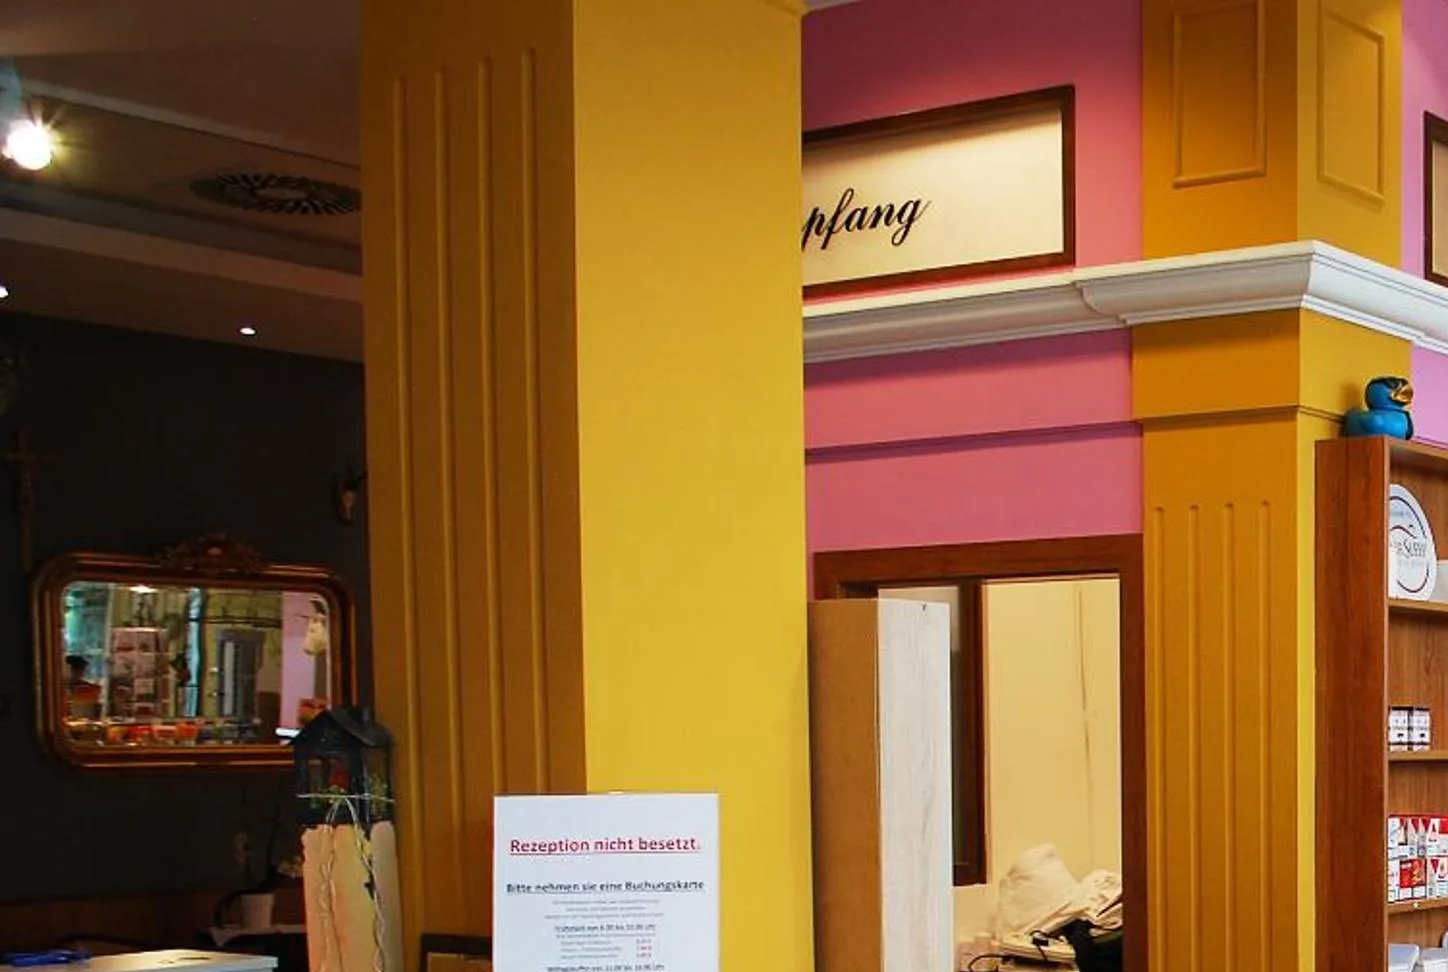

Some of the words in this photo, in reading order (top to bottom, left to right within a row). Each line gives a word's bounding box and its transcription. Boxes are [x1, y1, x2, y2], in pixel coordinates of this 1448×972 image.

[510, 838, 590, 855] Rezeption
[593, 837, 634, 852] nicht
[638, 835, 701, 851] besetzt.
[507, 882, 532, 893] Bitte
[535, 882, 579, 893] nehmen
[582, 881, 597, 892] sie
[600, 882, 622, 892] eine
[625, 879, 705, 893] Buchungskarte
